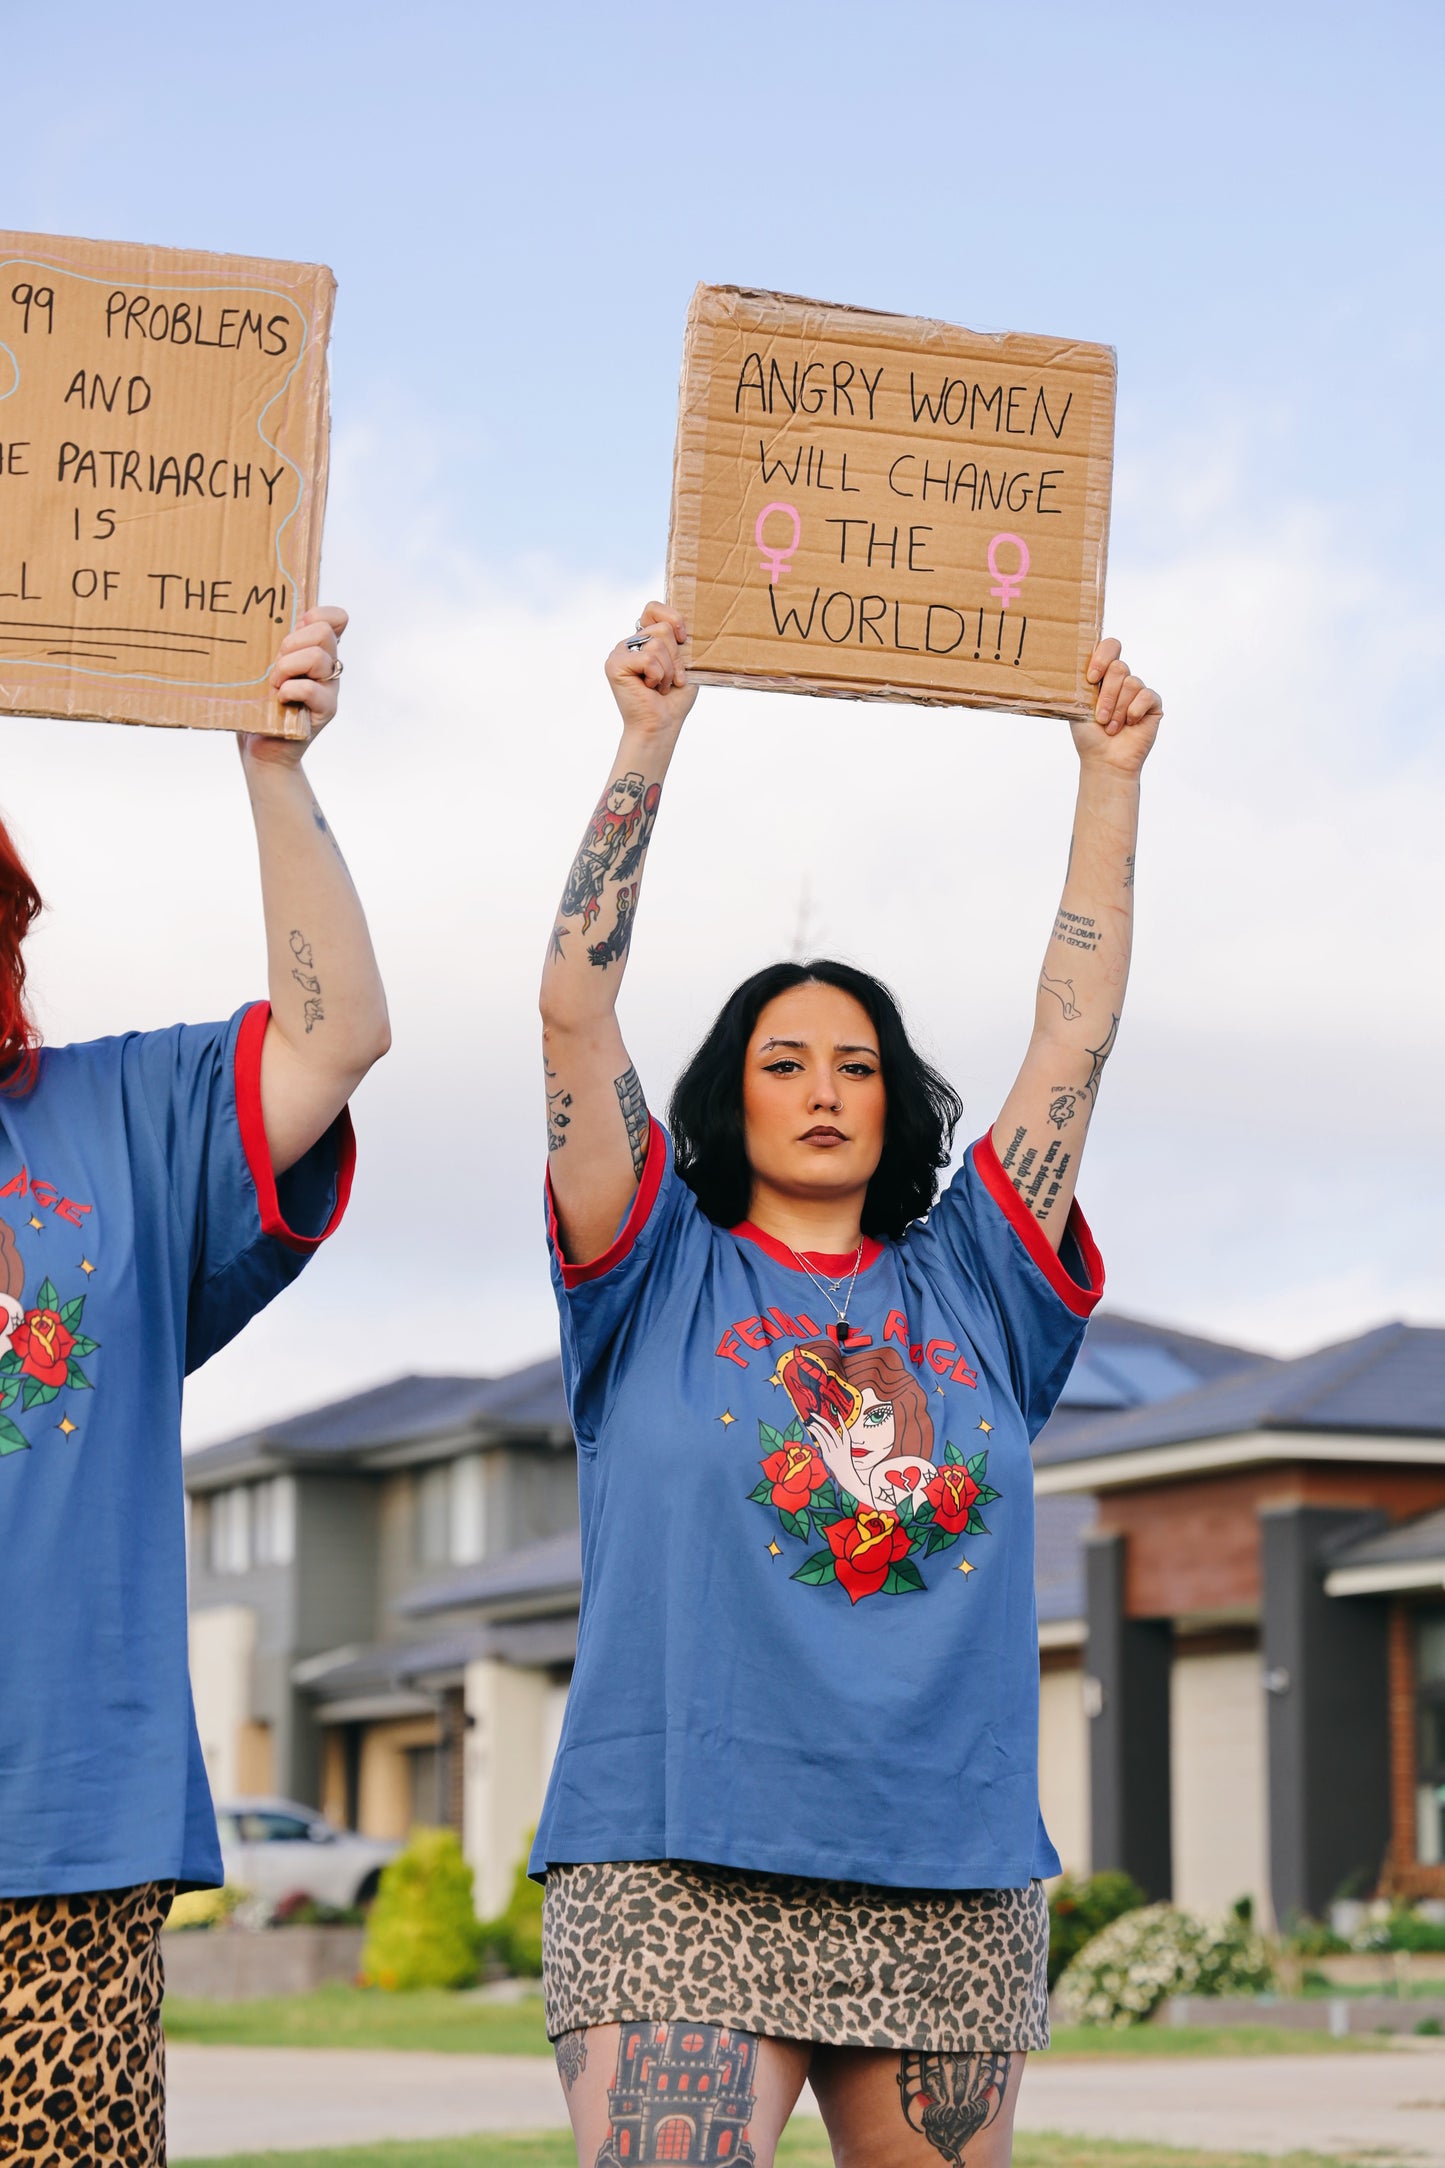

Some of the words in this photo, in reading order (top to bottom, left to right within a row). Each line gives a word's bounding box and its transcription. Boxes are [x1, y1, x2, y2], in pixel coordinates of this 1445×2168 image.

[12, 283, 54, 334] 99
[106, 290, 290, 356] PROBLEMS
[64, 369, 151, 416] AND
[735, 352, 884, 421] ANGRY
[910, 371, 1073, 439] WOMEN
[58, 441, 285, 506] PATRIARCHY
[759, 439, 860, 492] WILL
[888, 454, 1065, 514] CHANGE
[74, 507, 116, 541] IS
[825, 519, 935, 572] THE
[72, 569, 121, 601] OF
[147, 573, 286, 624] THEM!
[768, 583, 1027, 666] WORLD!!!
